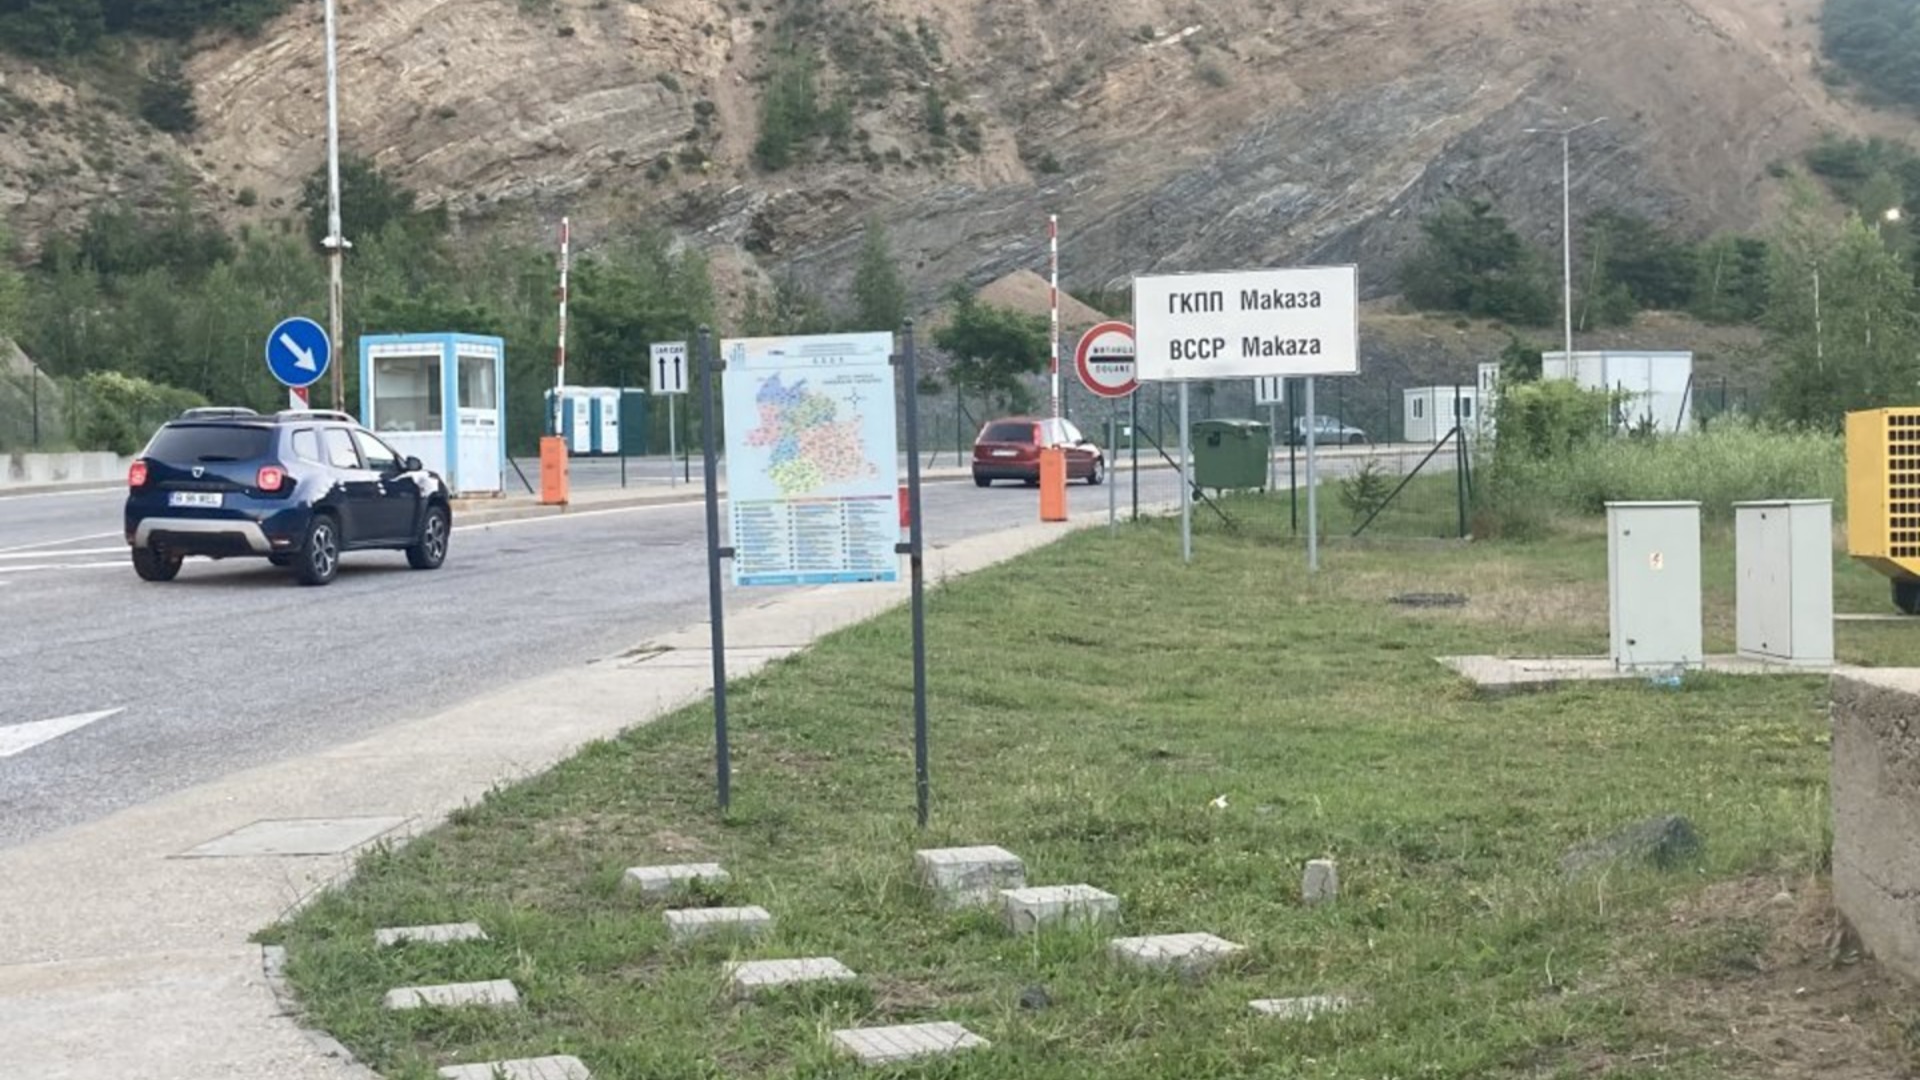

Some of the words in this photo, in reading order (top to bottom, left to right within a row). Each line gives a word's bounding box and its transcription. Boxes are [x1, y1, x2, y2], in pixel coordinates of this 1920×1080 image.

[1169, 291, 1223, 314] ГКПП
[1240, 289, 1321, 311] Маказа
[1169, 338, 1225, 360] BCCP
[1242, 335, 1321, 357] Makaza
